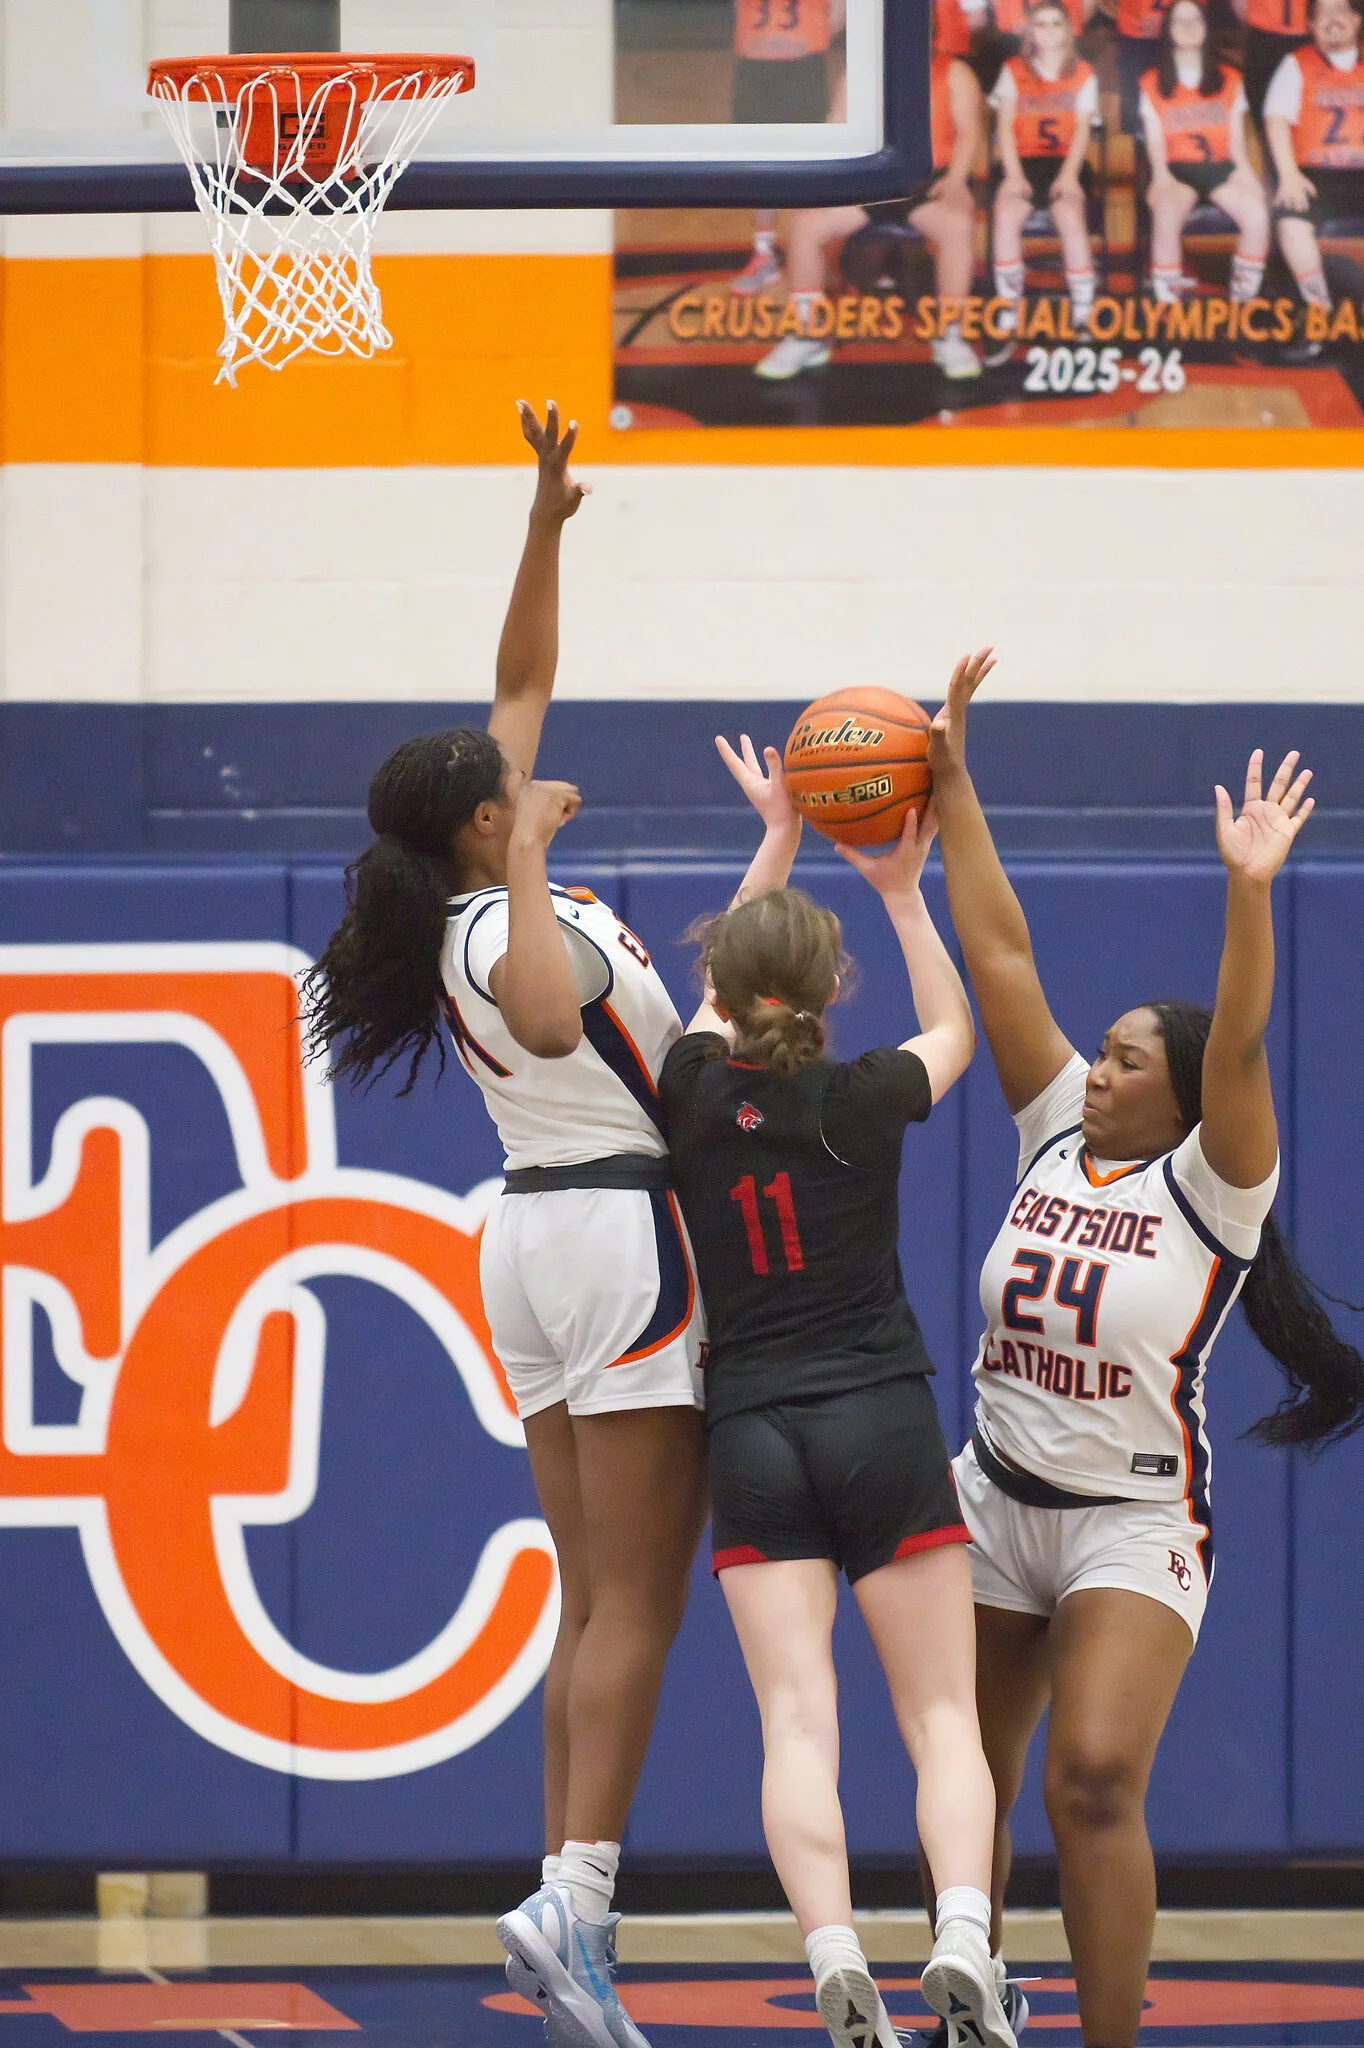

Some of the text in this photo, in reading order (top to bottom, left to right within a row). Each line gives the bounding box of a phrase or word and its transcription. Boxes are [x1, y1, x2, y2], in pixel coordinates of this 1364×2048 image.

[1038, 118, 1060, 150] 5
[667, 295, 905, 339] CRUSADERS
[913, 295, 1075, 340] SPECIAL
[1089, 296, 1295, 342] OLYMPICS
[1023, 346, 1187, 393] 2025-26
[790, 717, 885, 755] Baden
[729, 1171, 804, 1274] 11
[1010, 1187, 1162, 1259] EASTSIDE
[1001, 1248, 1109, 1347] 24
[983, 1337, 1133, 1400] CATHOLIC
